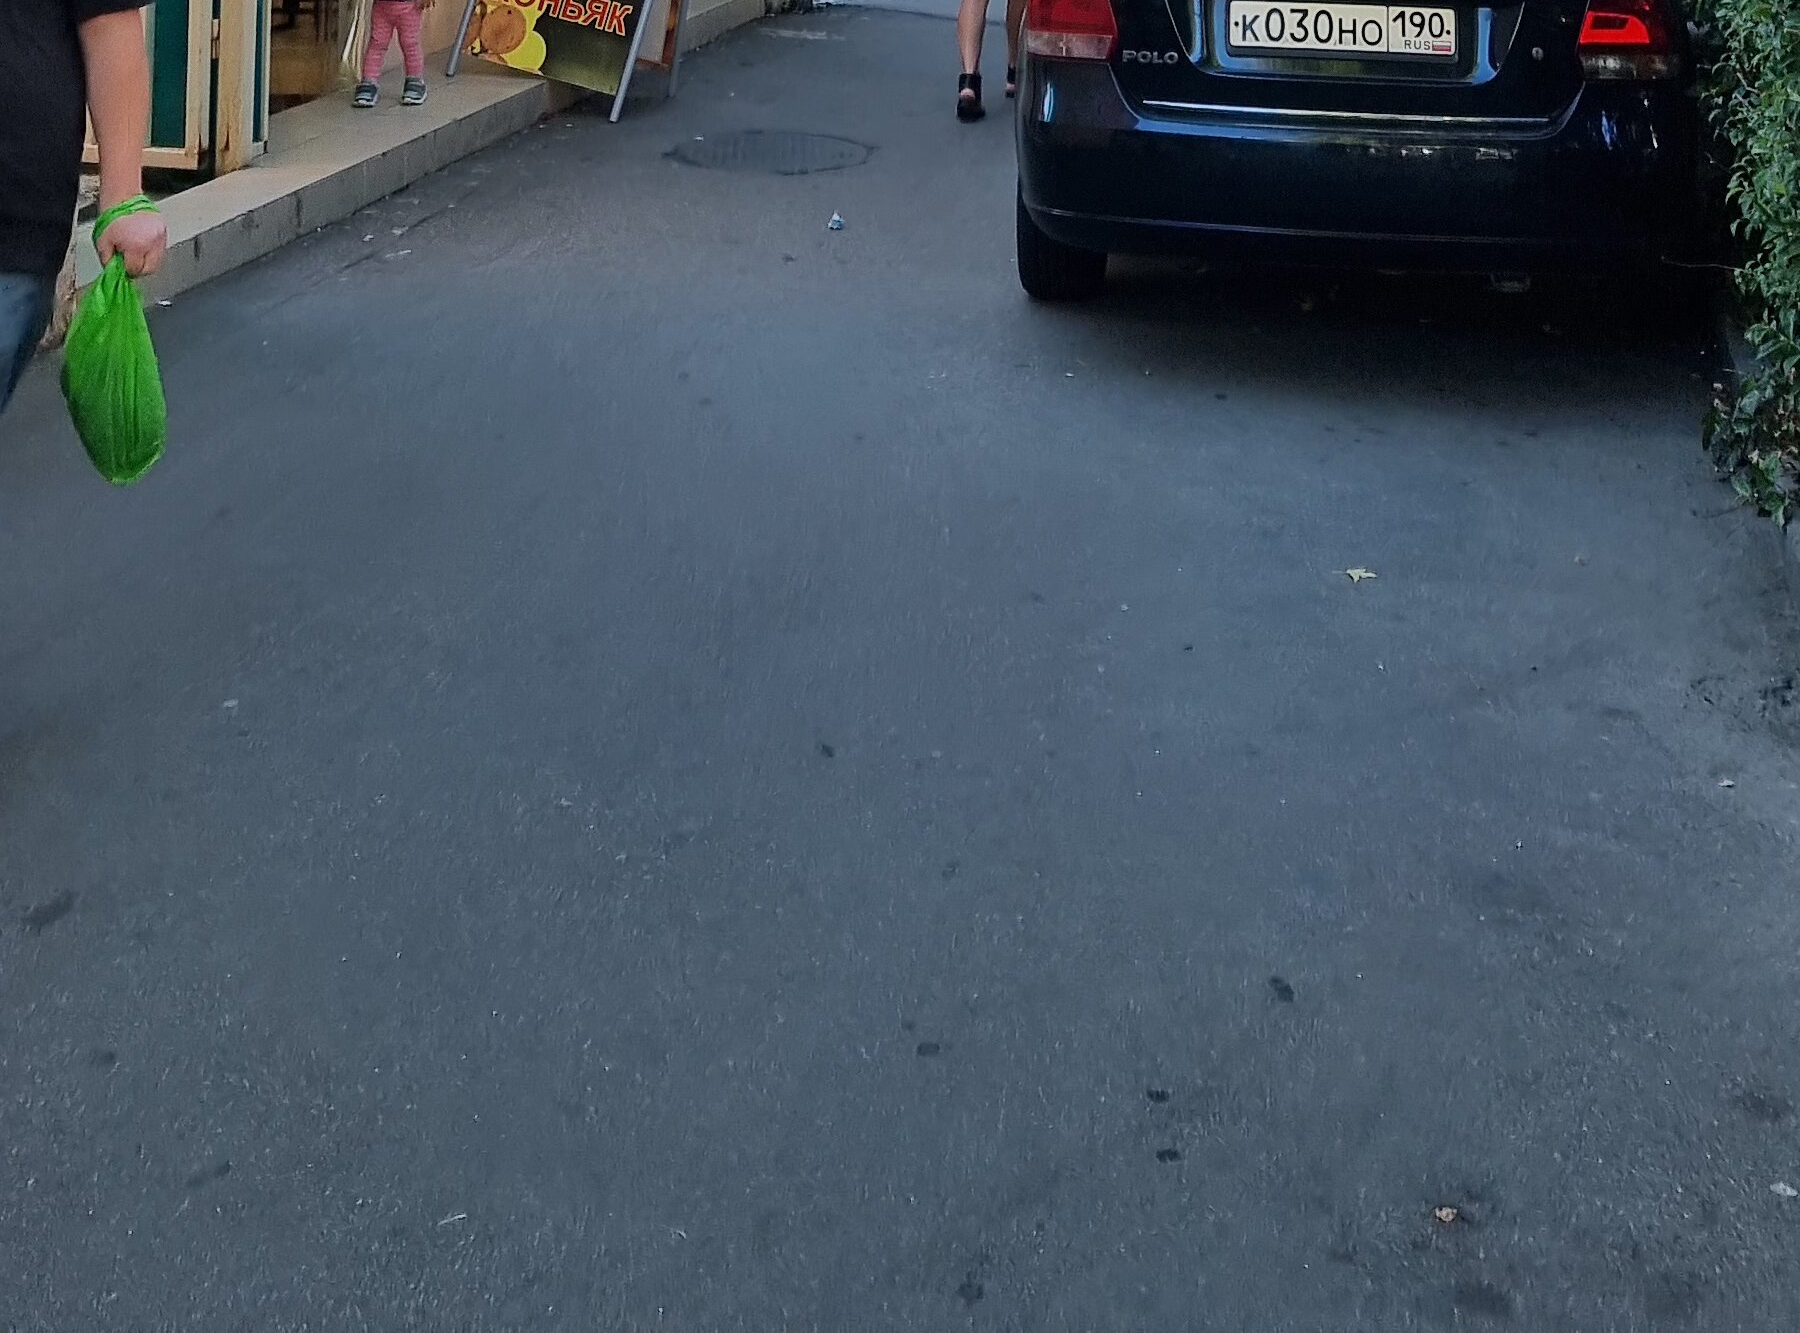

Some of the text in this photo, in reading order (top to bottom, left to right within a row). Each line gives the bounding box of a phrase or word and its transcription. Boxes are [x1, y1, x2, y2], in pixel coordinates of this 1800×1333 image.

[1242, 8, 1445, 46] К030НО 190
[1404, 39, 1431, 51] RUS
[1122, 49, 1179, 64] POLO
